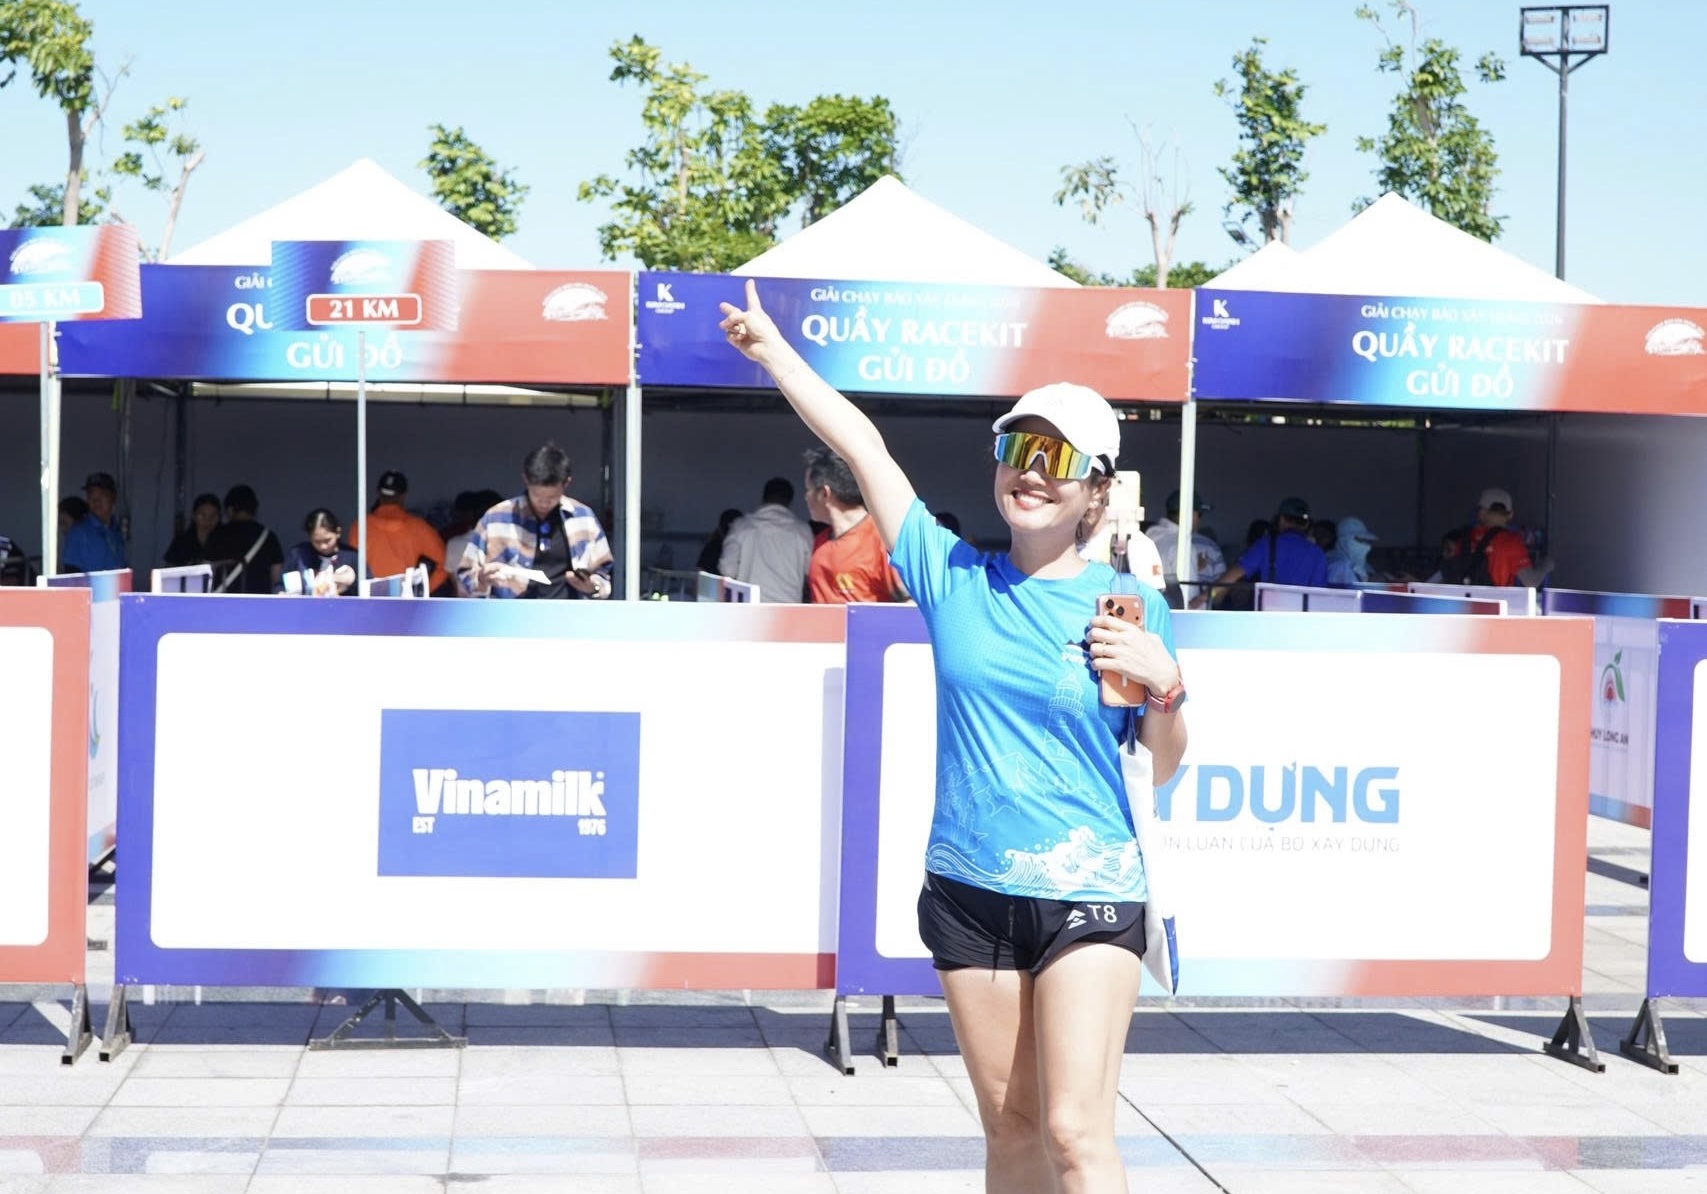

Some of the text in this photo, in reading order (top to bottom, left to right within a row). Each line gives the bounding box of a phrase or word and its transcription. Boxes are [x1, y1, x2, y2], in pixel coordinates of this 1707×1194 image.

[44, 287, 80, 308] KM
[329, 299, 399, 319] 21 KM
[901, 318, 1028, 348] RACEKIT
[1448, 334, 1570, 364] RACEKIT
[412, 768, 607, 816] Vinamilk
[412, 816, 435, 834] EST
[577, 818, 607, 836] 1976
[1087, 904, 1118, 924] T8
